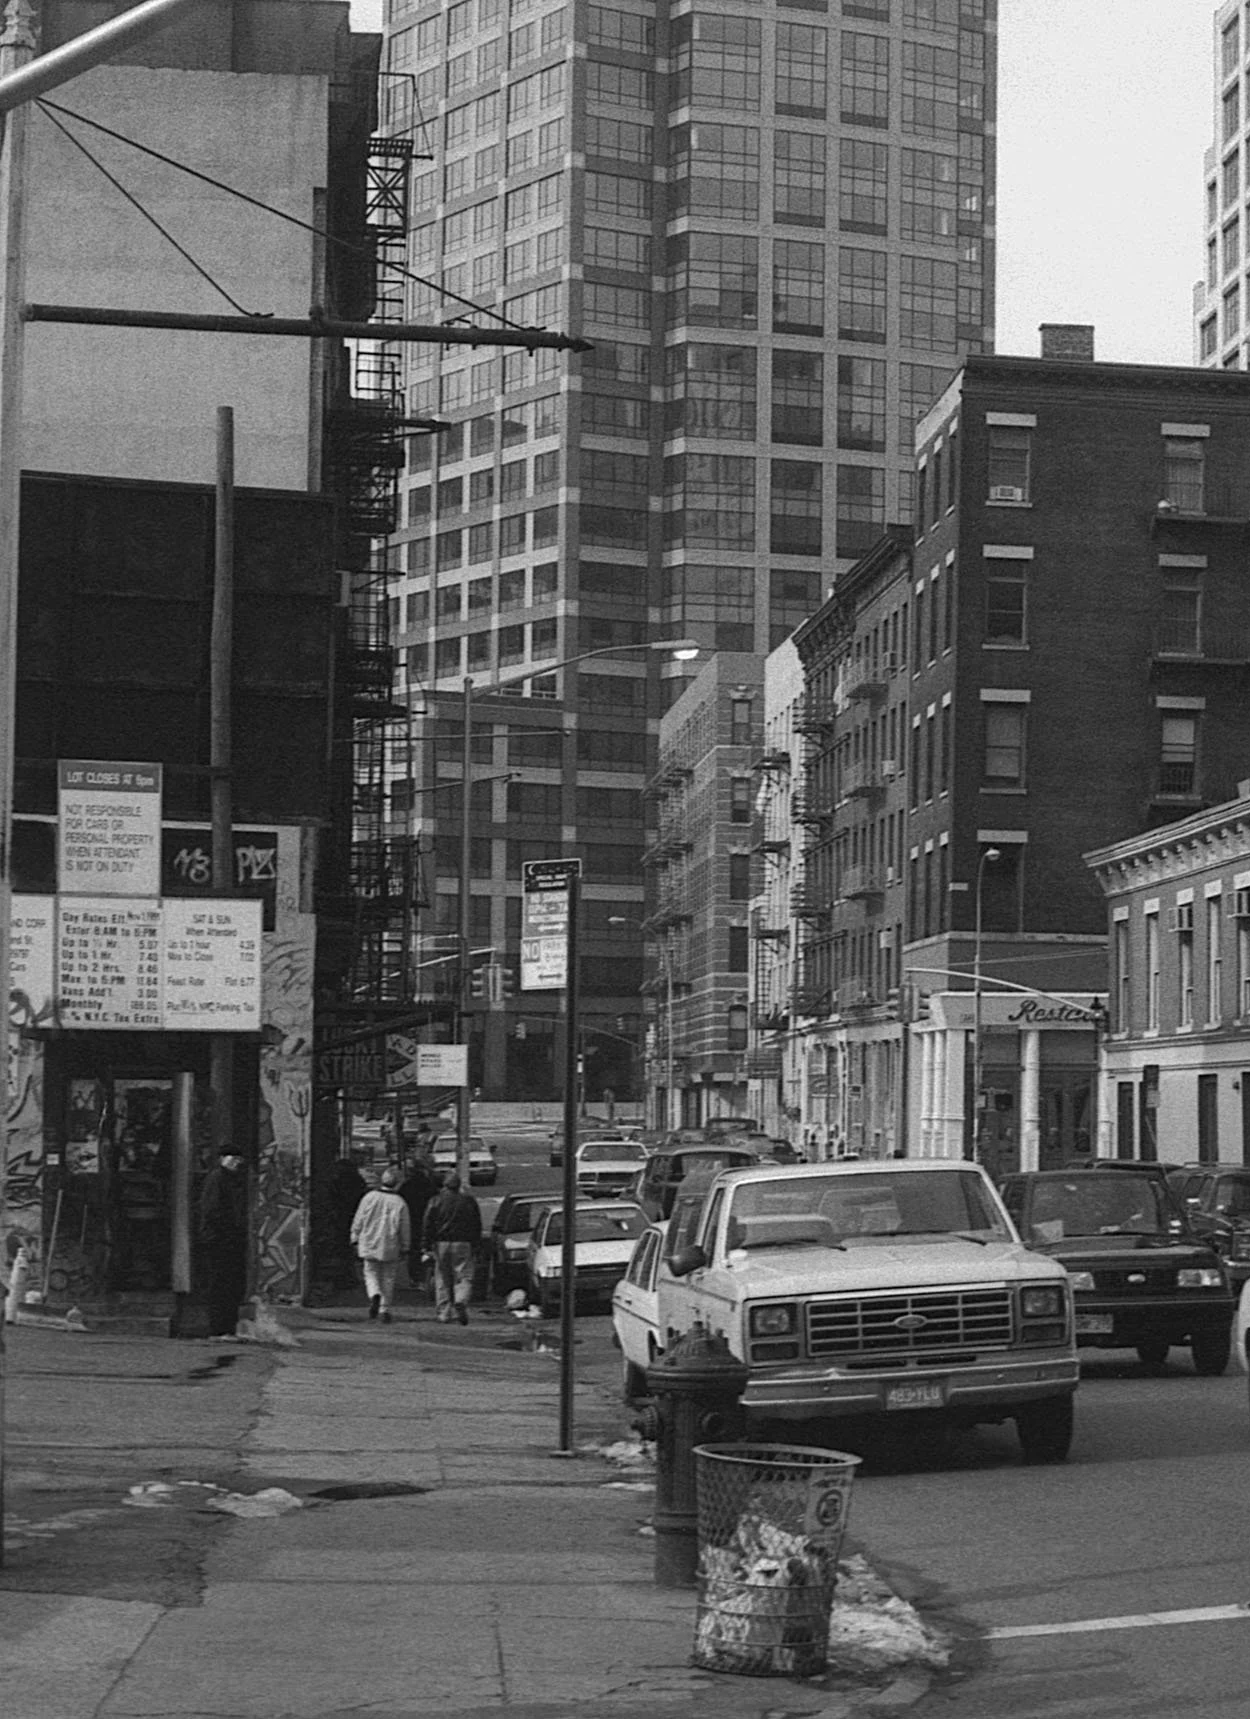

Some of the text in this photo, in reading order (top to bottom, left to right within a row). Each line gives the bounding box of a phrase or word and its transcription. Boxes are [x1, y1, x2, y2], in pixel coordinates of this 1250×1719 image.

[67, 771, 84, 783] LOT
[86, 771, 121, 785] CLOSES
[123, 773, 134, 785] AT
[65, 804, 142, 817] NOT RESPONSIBLE
[65, 831, 154, 845] PERSONAL PROPERTY
[94, 847, 141, 858] ATTENDANT
[62, 912, 79, 924] Day
[83, 912, 108, 924] Rates
[121, 927, 131, 937] to
[62, 937, 75, 948] Up
[79, 938, 89, 948] to
[62, 949, 74, 960] Up
[78, 950, 89, 960] to
[62, 962, 74, 973] Up
[78, 963, 88, 973] to
[91, 962, 99, 973] 2
[87, 975, 98, 985] to
[61, 998, 102, 1010] Monthly
[319, 1055, 384, 1082] STRIKE
